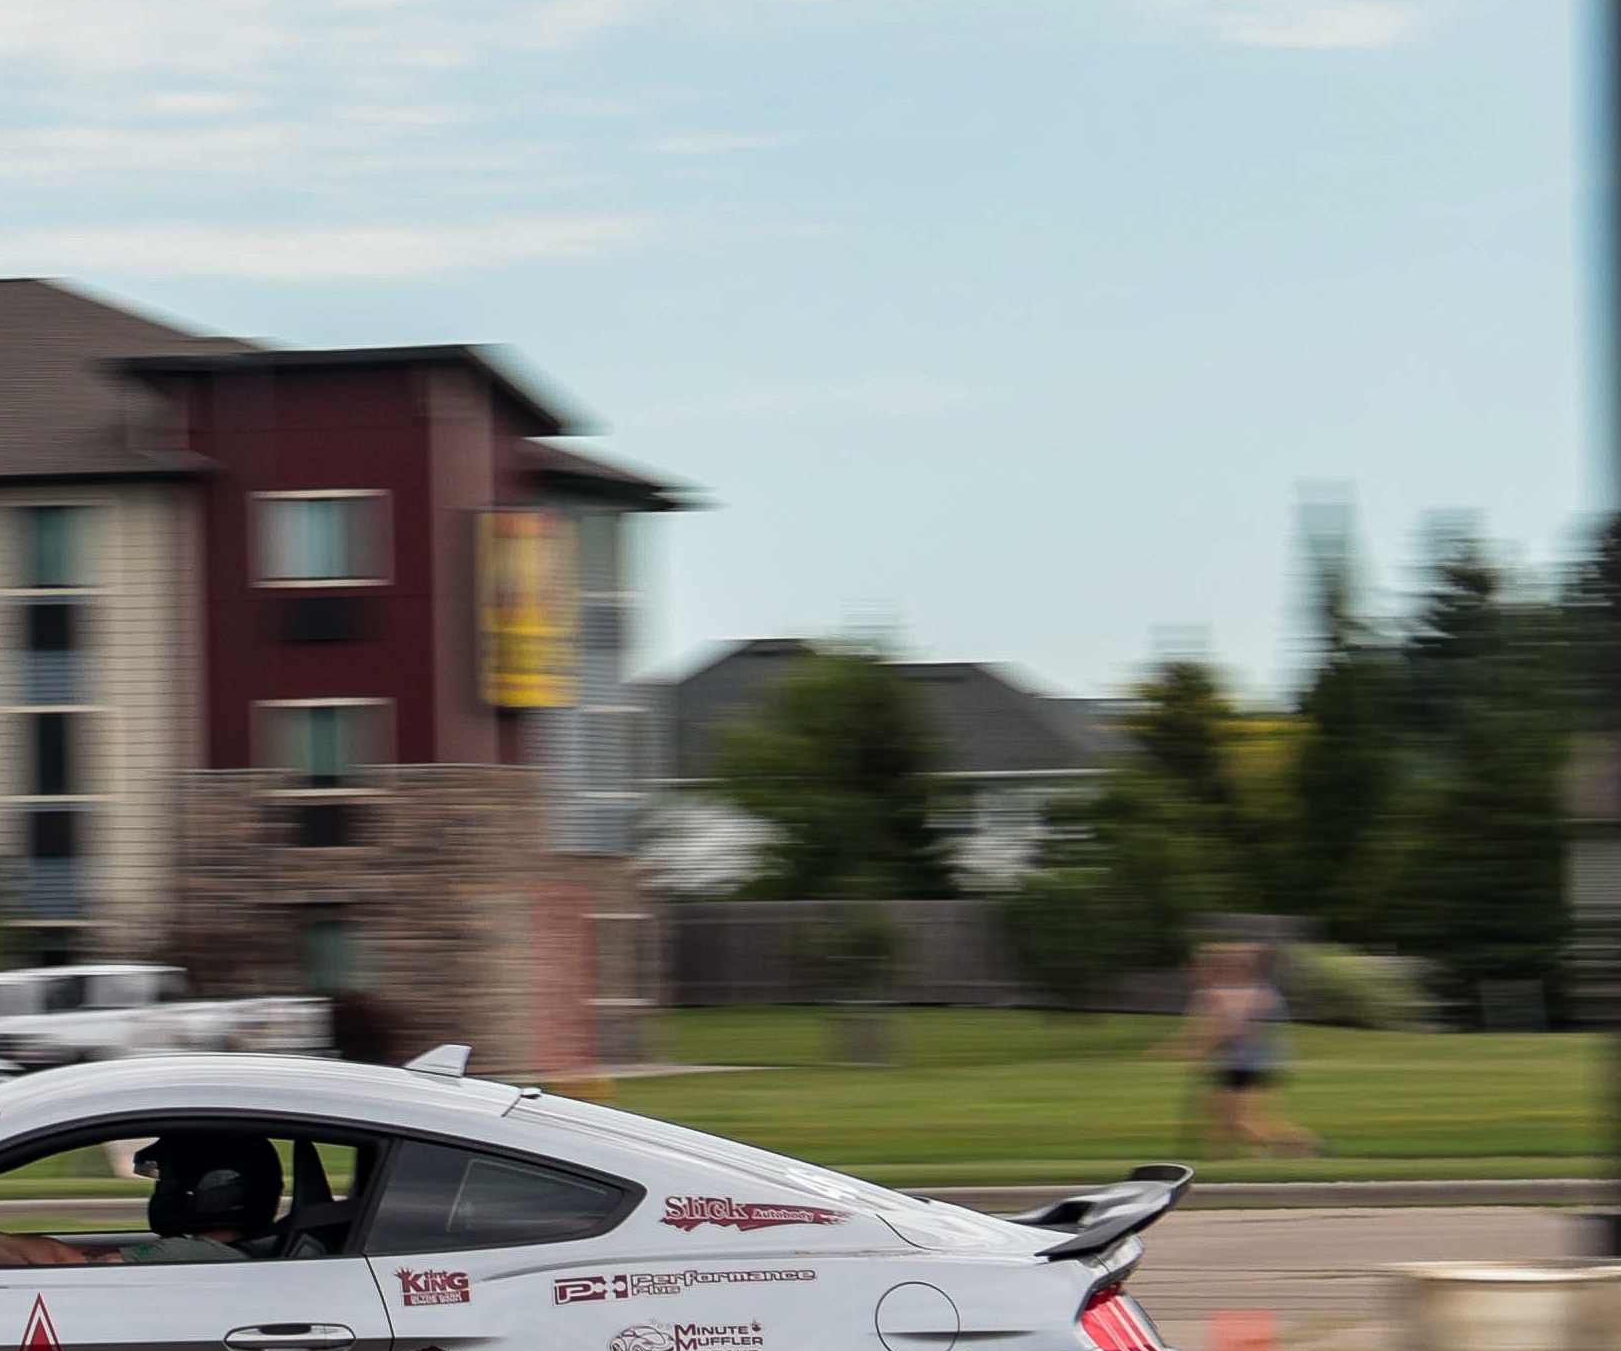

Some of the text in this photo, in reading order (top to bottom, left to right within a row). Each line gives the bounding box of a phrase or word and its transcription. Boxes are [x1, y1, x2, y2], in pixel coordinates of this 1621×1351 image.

[665, 1195, 749, 1220] Slick
[631, 1269, 817, 1288] Performance
[631, 1284, 681, 1296] Plus
[674, 1323, 749, 1337] MINUTE
[678, 1336, 764, 1351] MUFFLER
